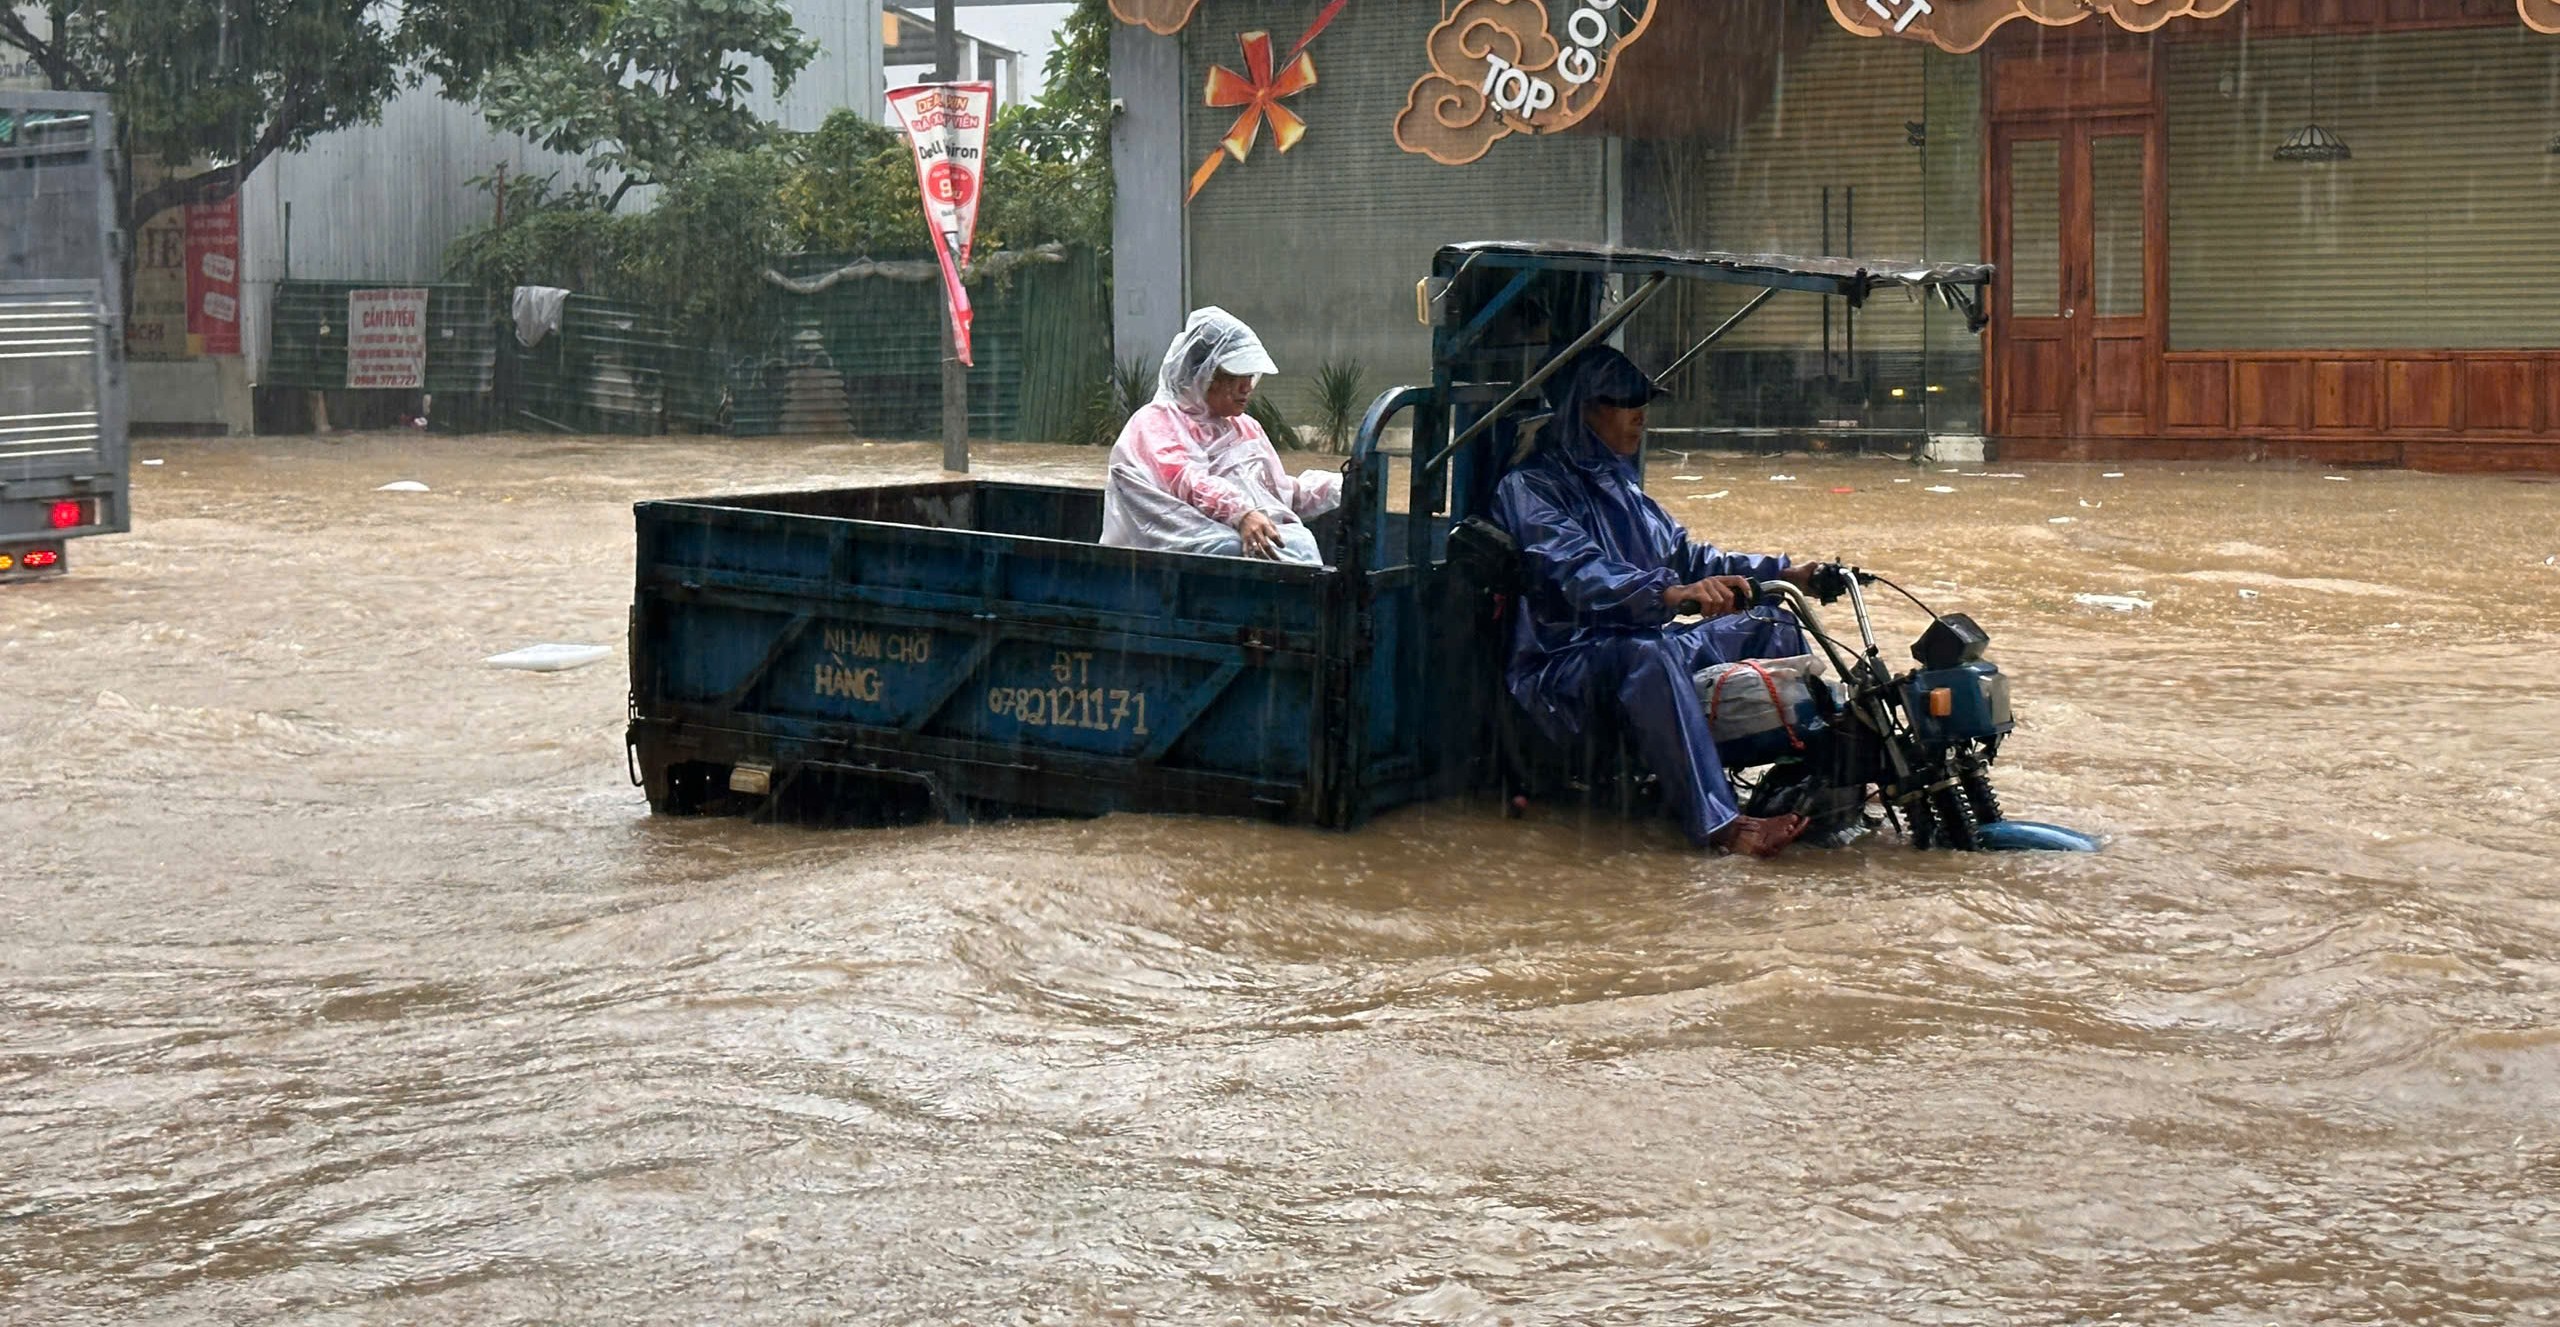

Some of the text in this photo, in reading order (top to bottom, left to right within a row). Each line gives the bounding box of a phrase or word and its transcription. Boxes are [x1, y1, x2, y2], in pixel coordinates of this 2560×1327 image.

[1482, 0, 1618, 119] TOP GO
[919, 140, 943, 160] Dell
[815, 652, 884, 702] HÀNG
[988, 686, 1149, 735] 0782121171
